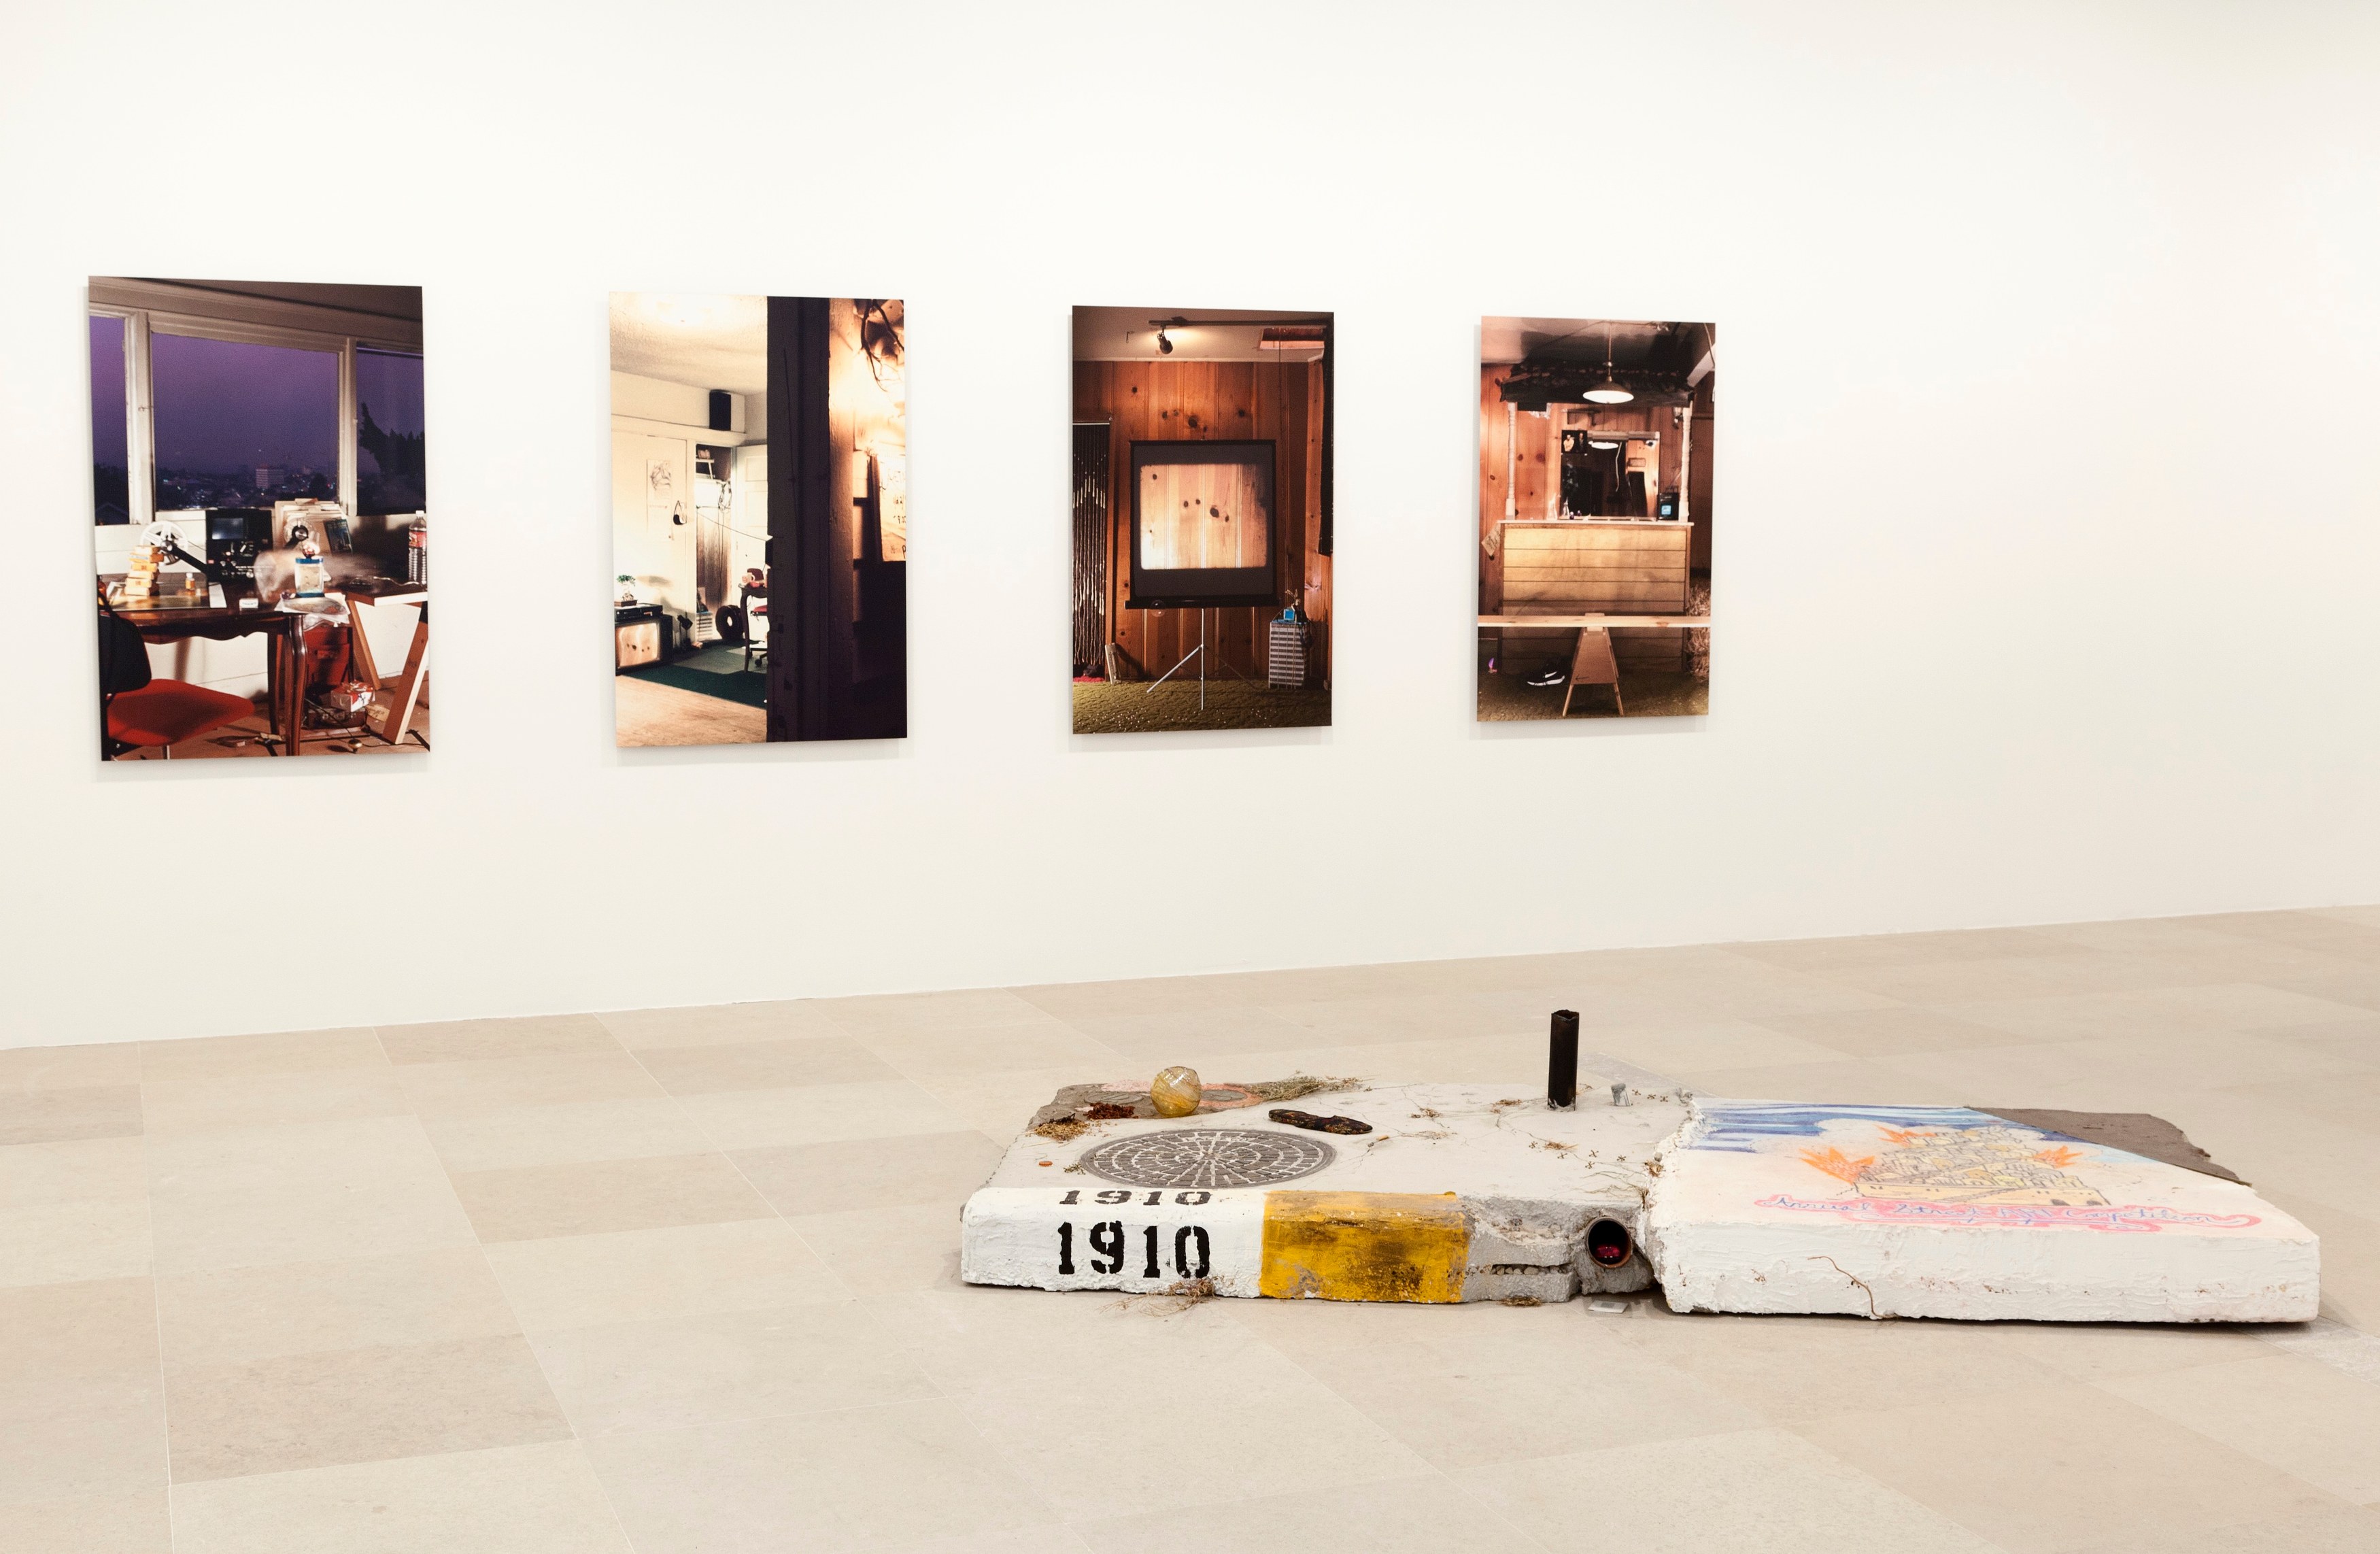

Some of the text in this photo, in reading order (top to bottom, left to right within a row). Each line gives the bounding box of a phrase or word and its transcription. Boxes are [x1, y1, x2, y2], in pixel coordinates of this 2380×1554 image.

[1059, 1189, 1212, 1206] 1910
[1763, 1197, 1871, 1211] Annual
[1893, 1203, 1984, 1215] Street
[1057, 1220, 1210, 1279] 1910
